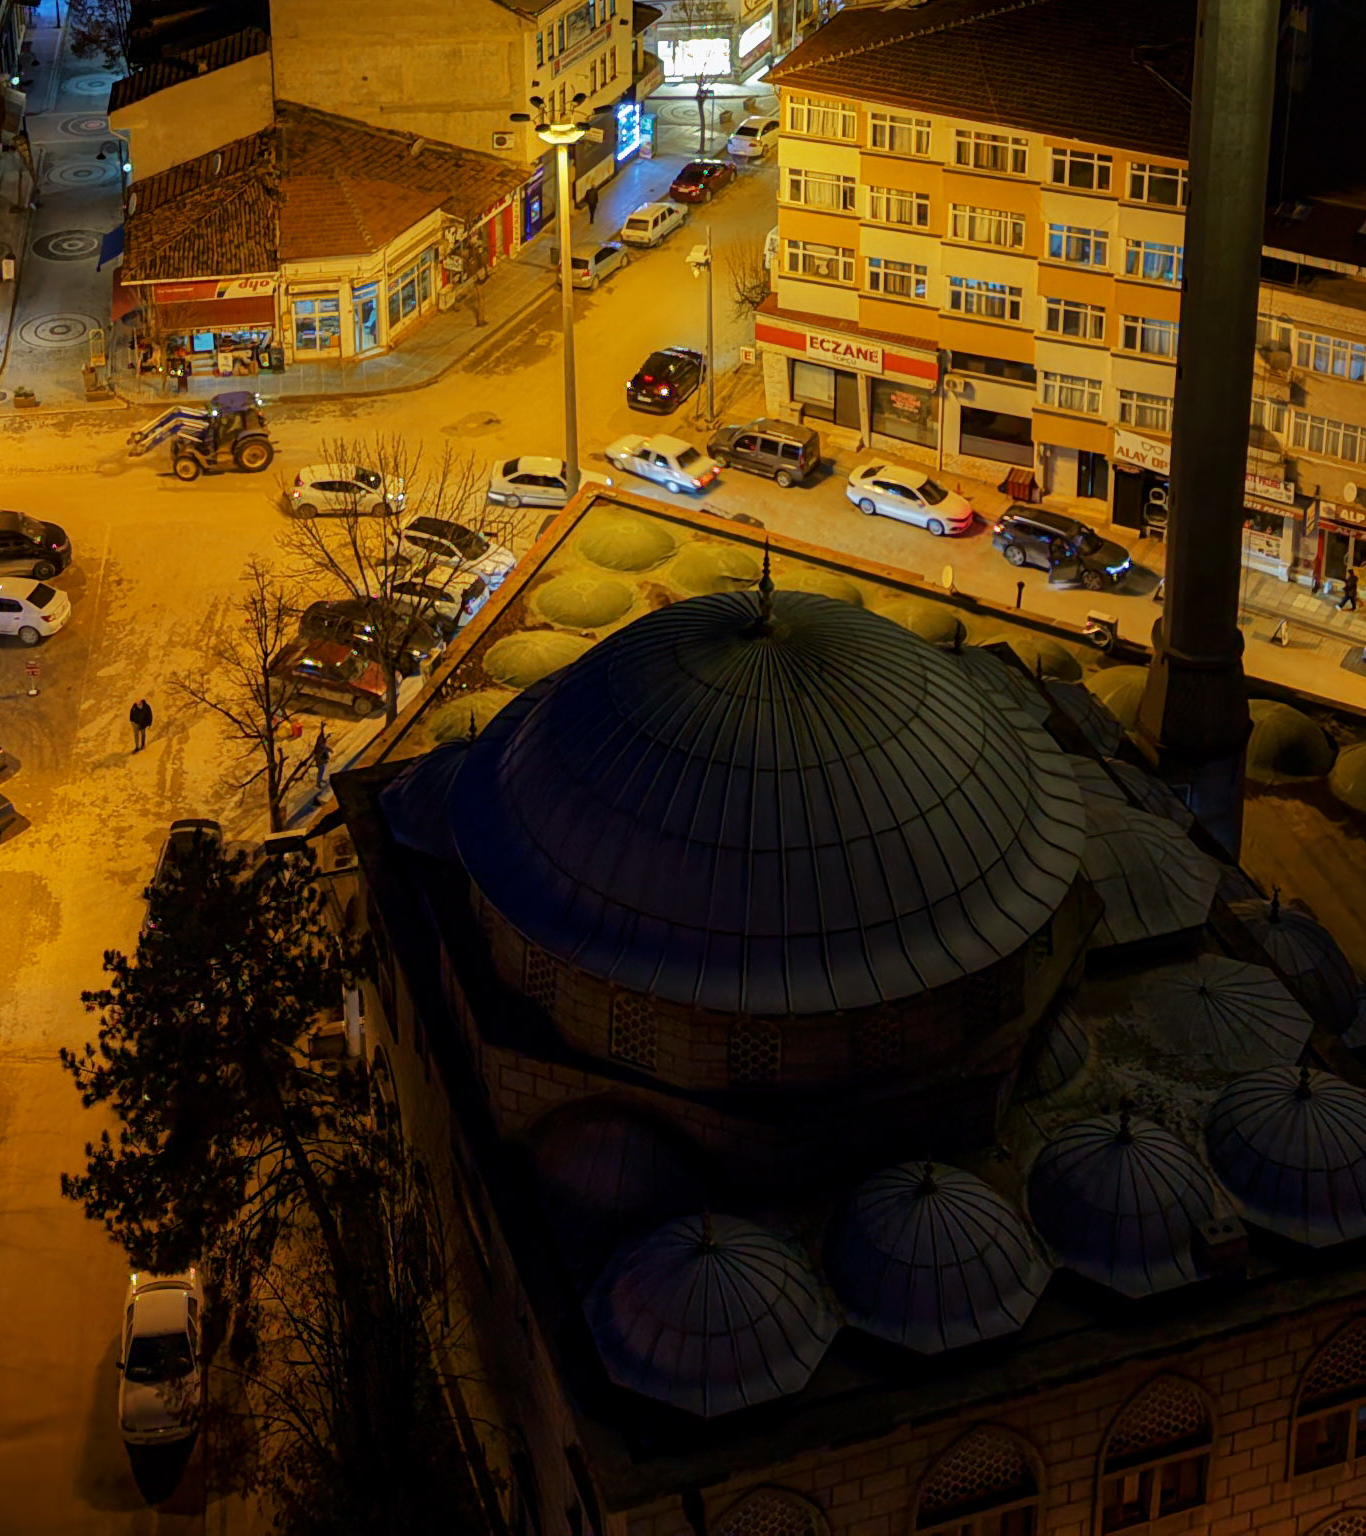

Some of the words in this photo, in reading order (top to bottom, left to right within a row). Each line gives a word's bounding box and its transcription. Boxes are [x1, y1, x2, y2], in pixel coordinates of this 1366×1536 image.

[809, 335, 879, 364] ECZANE
[1115, 445, 1148, 465] ALAY
[1151, 456, 1169, 471] OP
[1339, 509, 1366, 524] ALP
